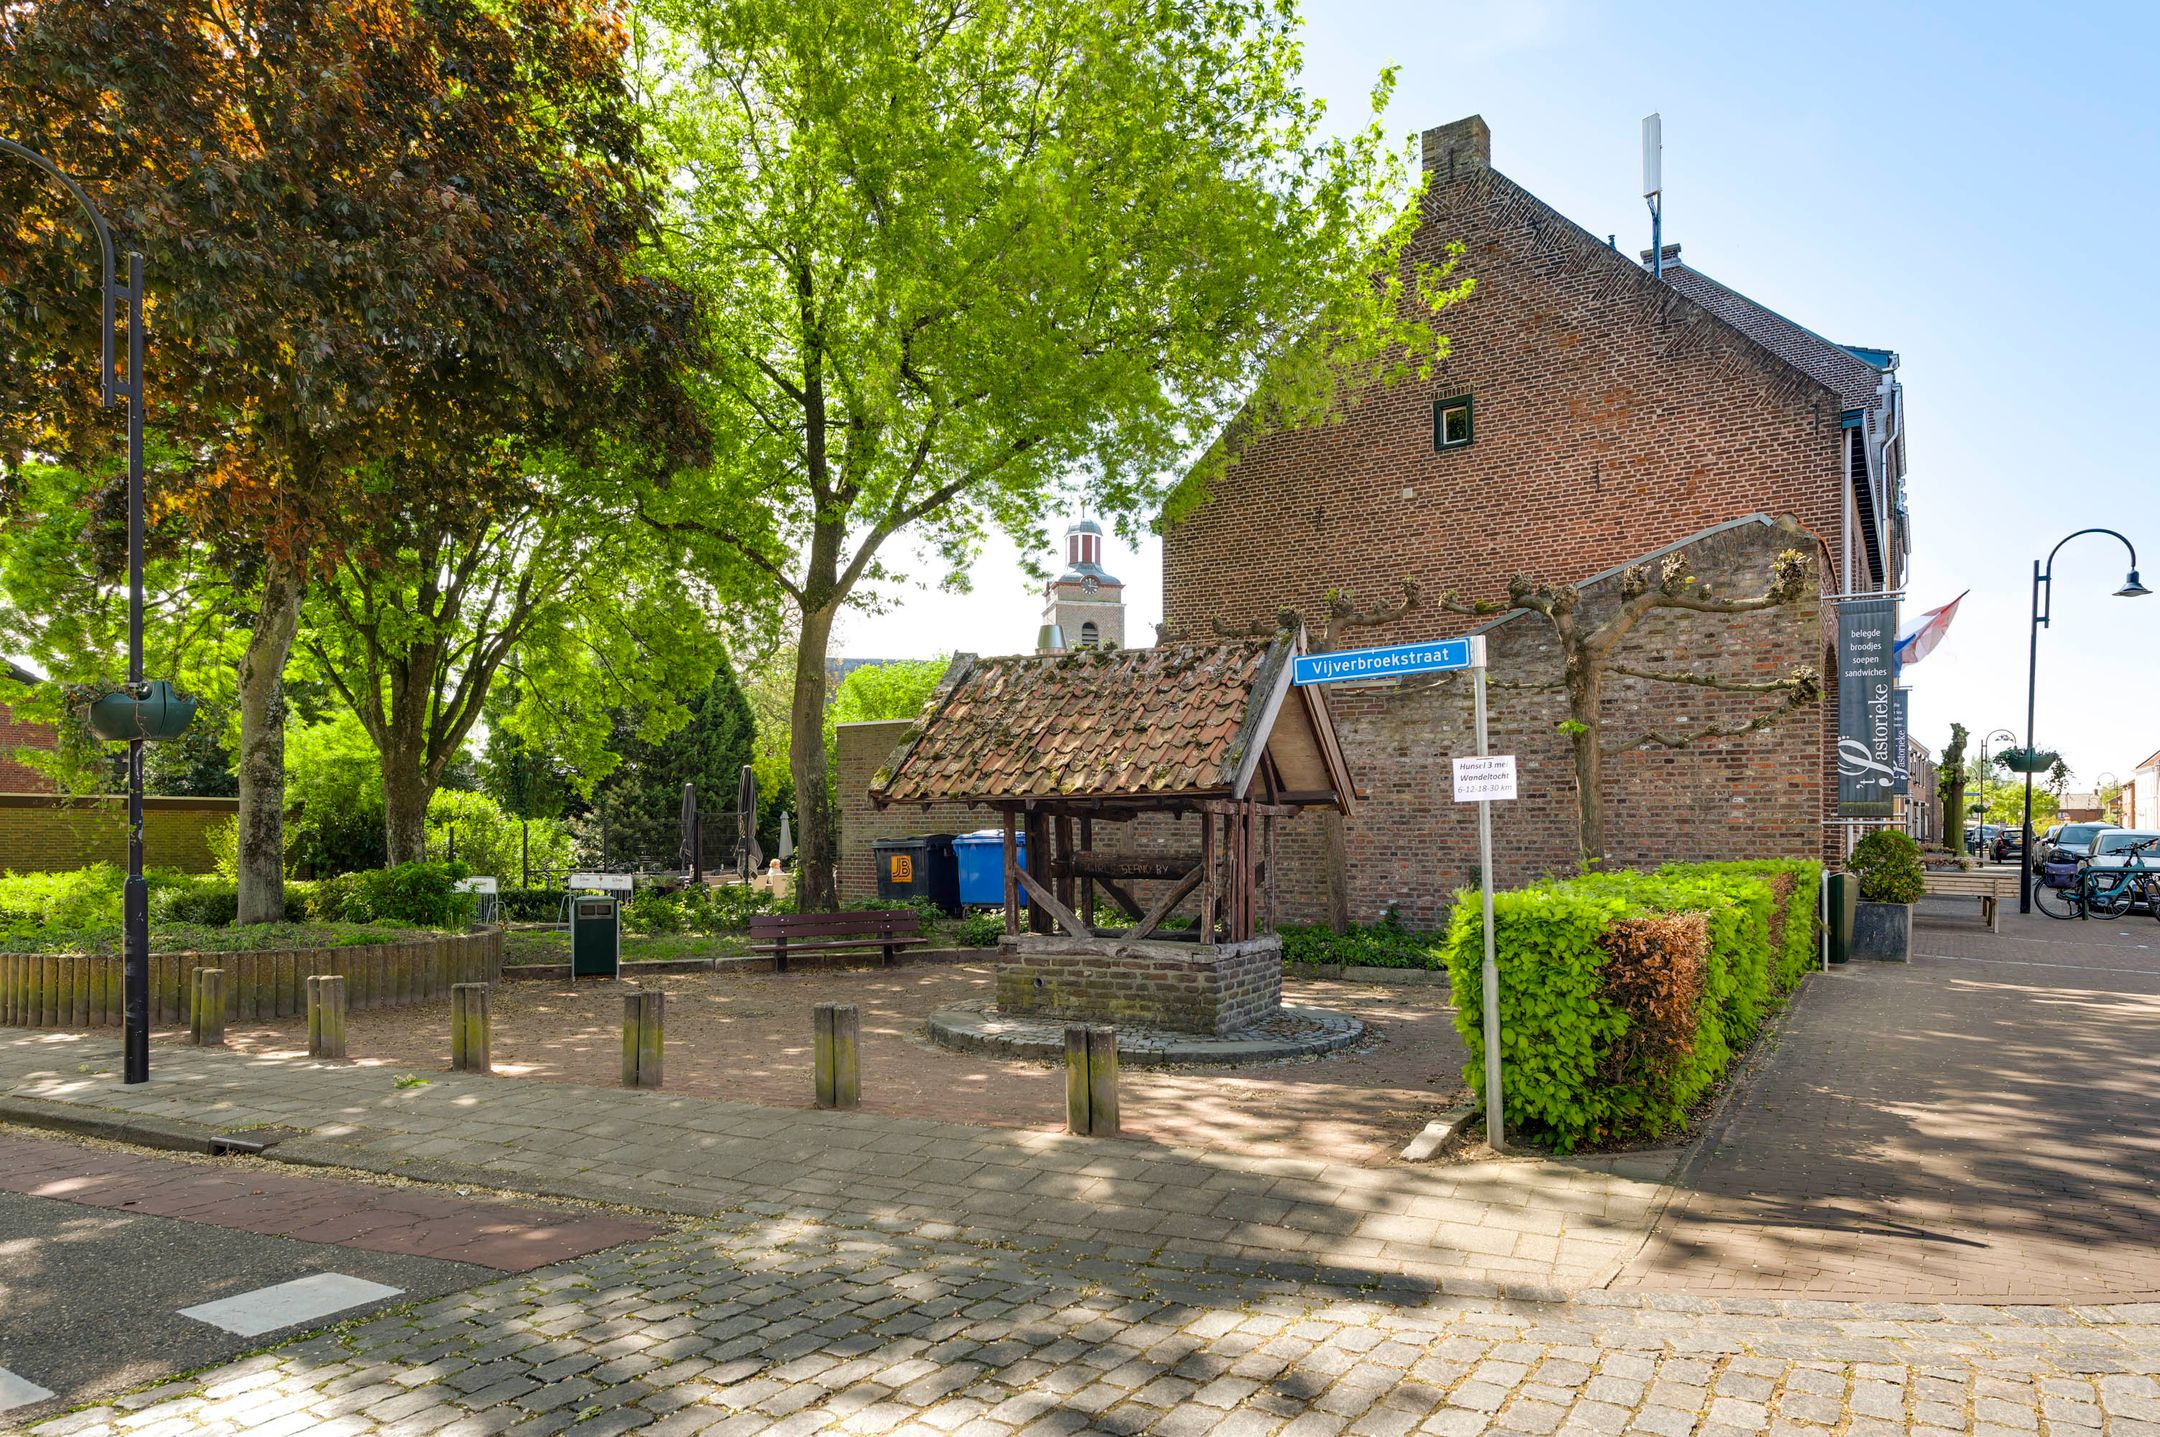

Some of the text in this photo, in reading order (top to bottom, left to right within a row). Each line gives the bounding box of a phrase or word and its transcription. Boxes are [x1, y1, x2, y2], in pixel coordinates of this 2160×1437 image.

[1851, 629, 1881, 639] belegde
[1850, 642, 1882, 652] broodjes
[1312, 647, 1449, 678] Vijverbroekstraat
[1852, 656, 1879, 665] soepen
[1845, 668, 1887, 677] sandwiches
[1460, 761, 1486, 770] Hunsel
[1487, 761, 1493, 769] 3
[1460, 773, 1509, 781] Wandeltocht
[1458, 785, 1499, 793] 6-12-18-30
